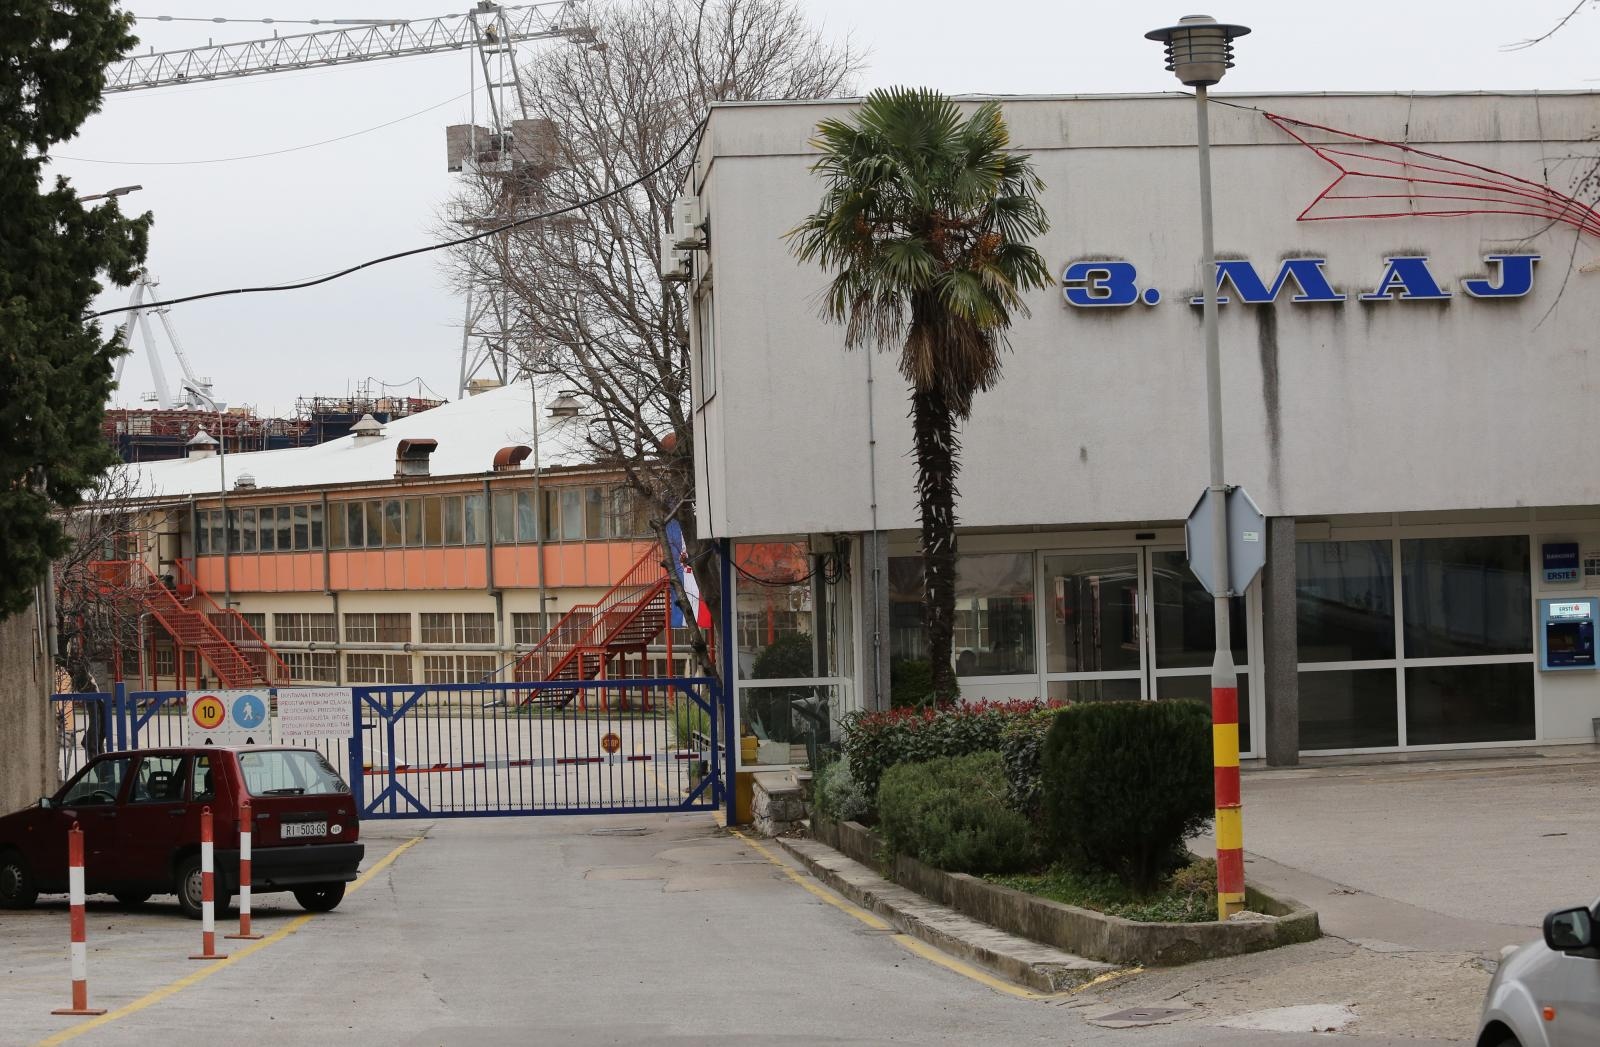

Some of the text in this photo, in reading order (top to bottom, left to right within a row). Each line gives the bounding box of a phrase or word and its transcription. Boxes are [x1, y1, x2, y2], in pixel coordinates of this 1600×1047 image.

[1062, 254, 1544, 307] 3. MAJ
[1547, 571, 1570, 580] ERSTE
[203, 705, 215, 719] 10
[286, 825, 295, 836] RI
